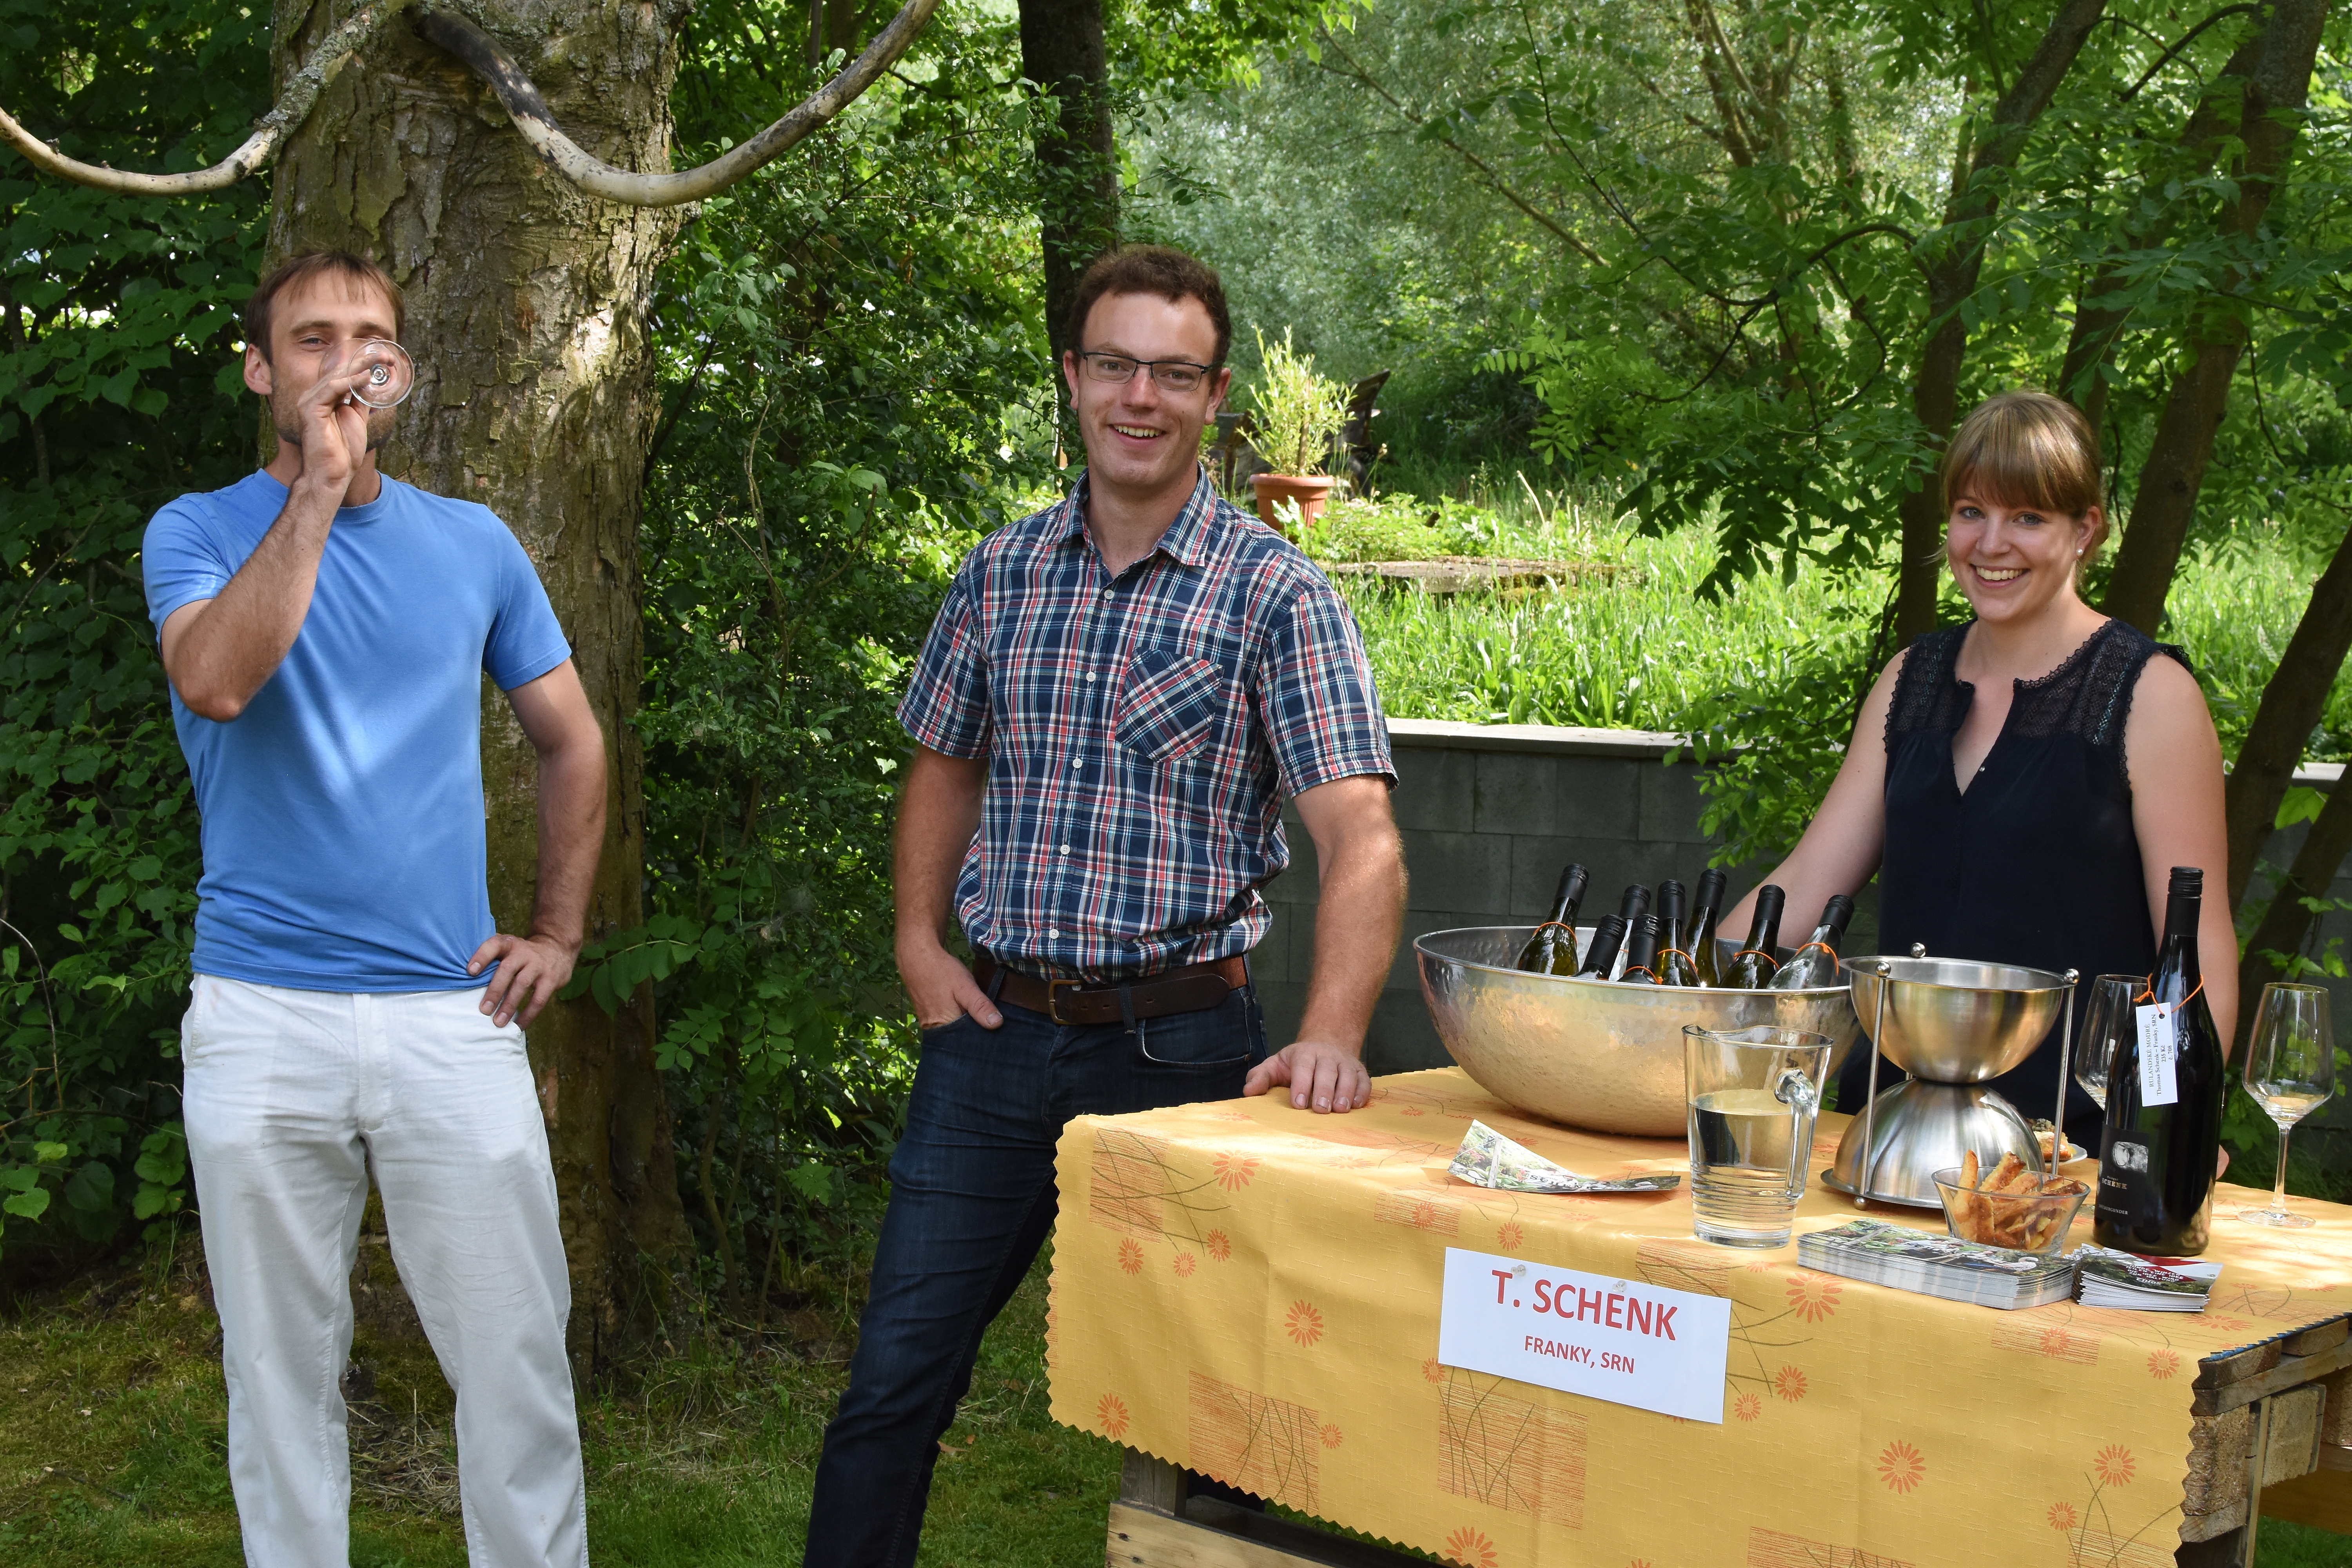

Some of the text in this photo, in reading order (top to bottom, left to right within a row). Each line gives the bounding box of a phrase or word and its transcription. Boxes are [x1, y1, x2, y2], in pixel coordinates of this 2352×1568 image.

[2102, 1178, 2127, 1189] SCHENK
[1492, 1270, 1678, 1341] T. SCHENK
[1525, 1336, 1634, 1374] FRANKY, SRN
